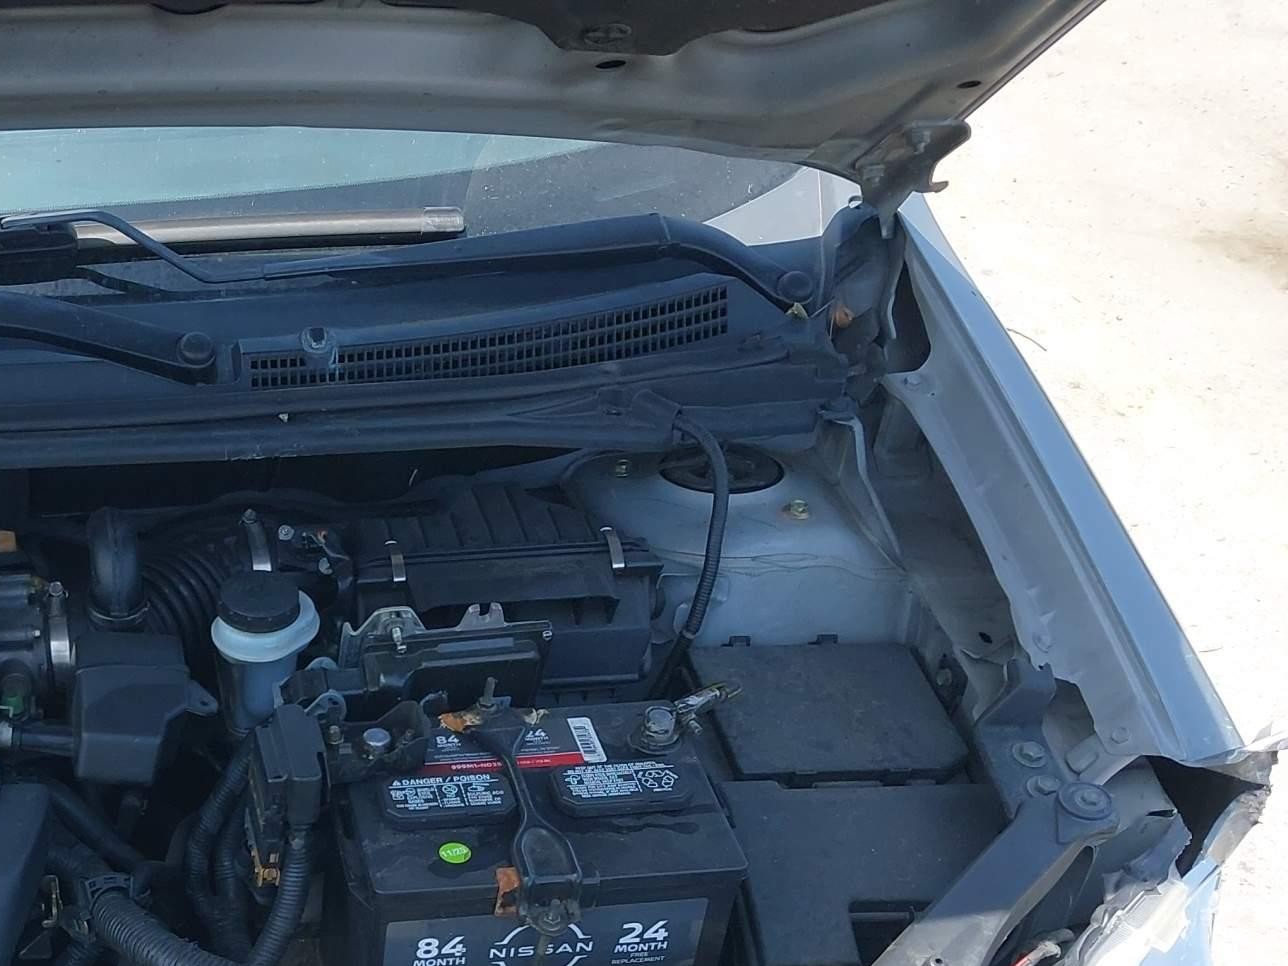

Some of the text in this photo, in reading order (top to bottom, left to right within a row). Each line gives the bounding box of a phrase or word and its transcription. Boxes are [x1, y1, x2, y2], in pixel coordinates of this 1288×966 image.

[435, 734, 460, 745] 84
[402, 775, 443, 786] DANGER
[453, 774, 491, 782] POISON
[618, 919, 669, 944] 24
[416, 935, 467, 959] 84
[613, 940, 668, 954] MONTH
[611, 955, 665, 965] REPLACEMENT
